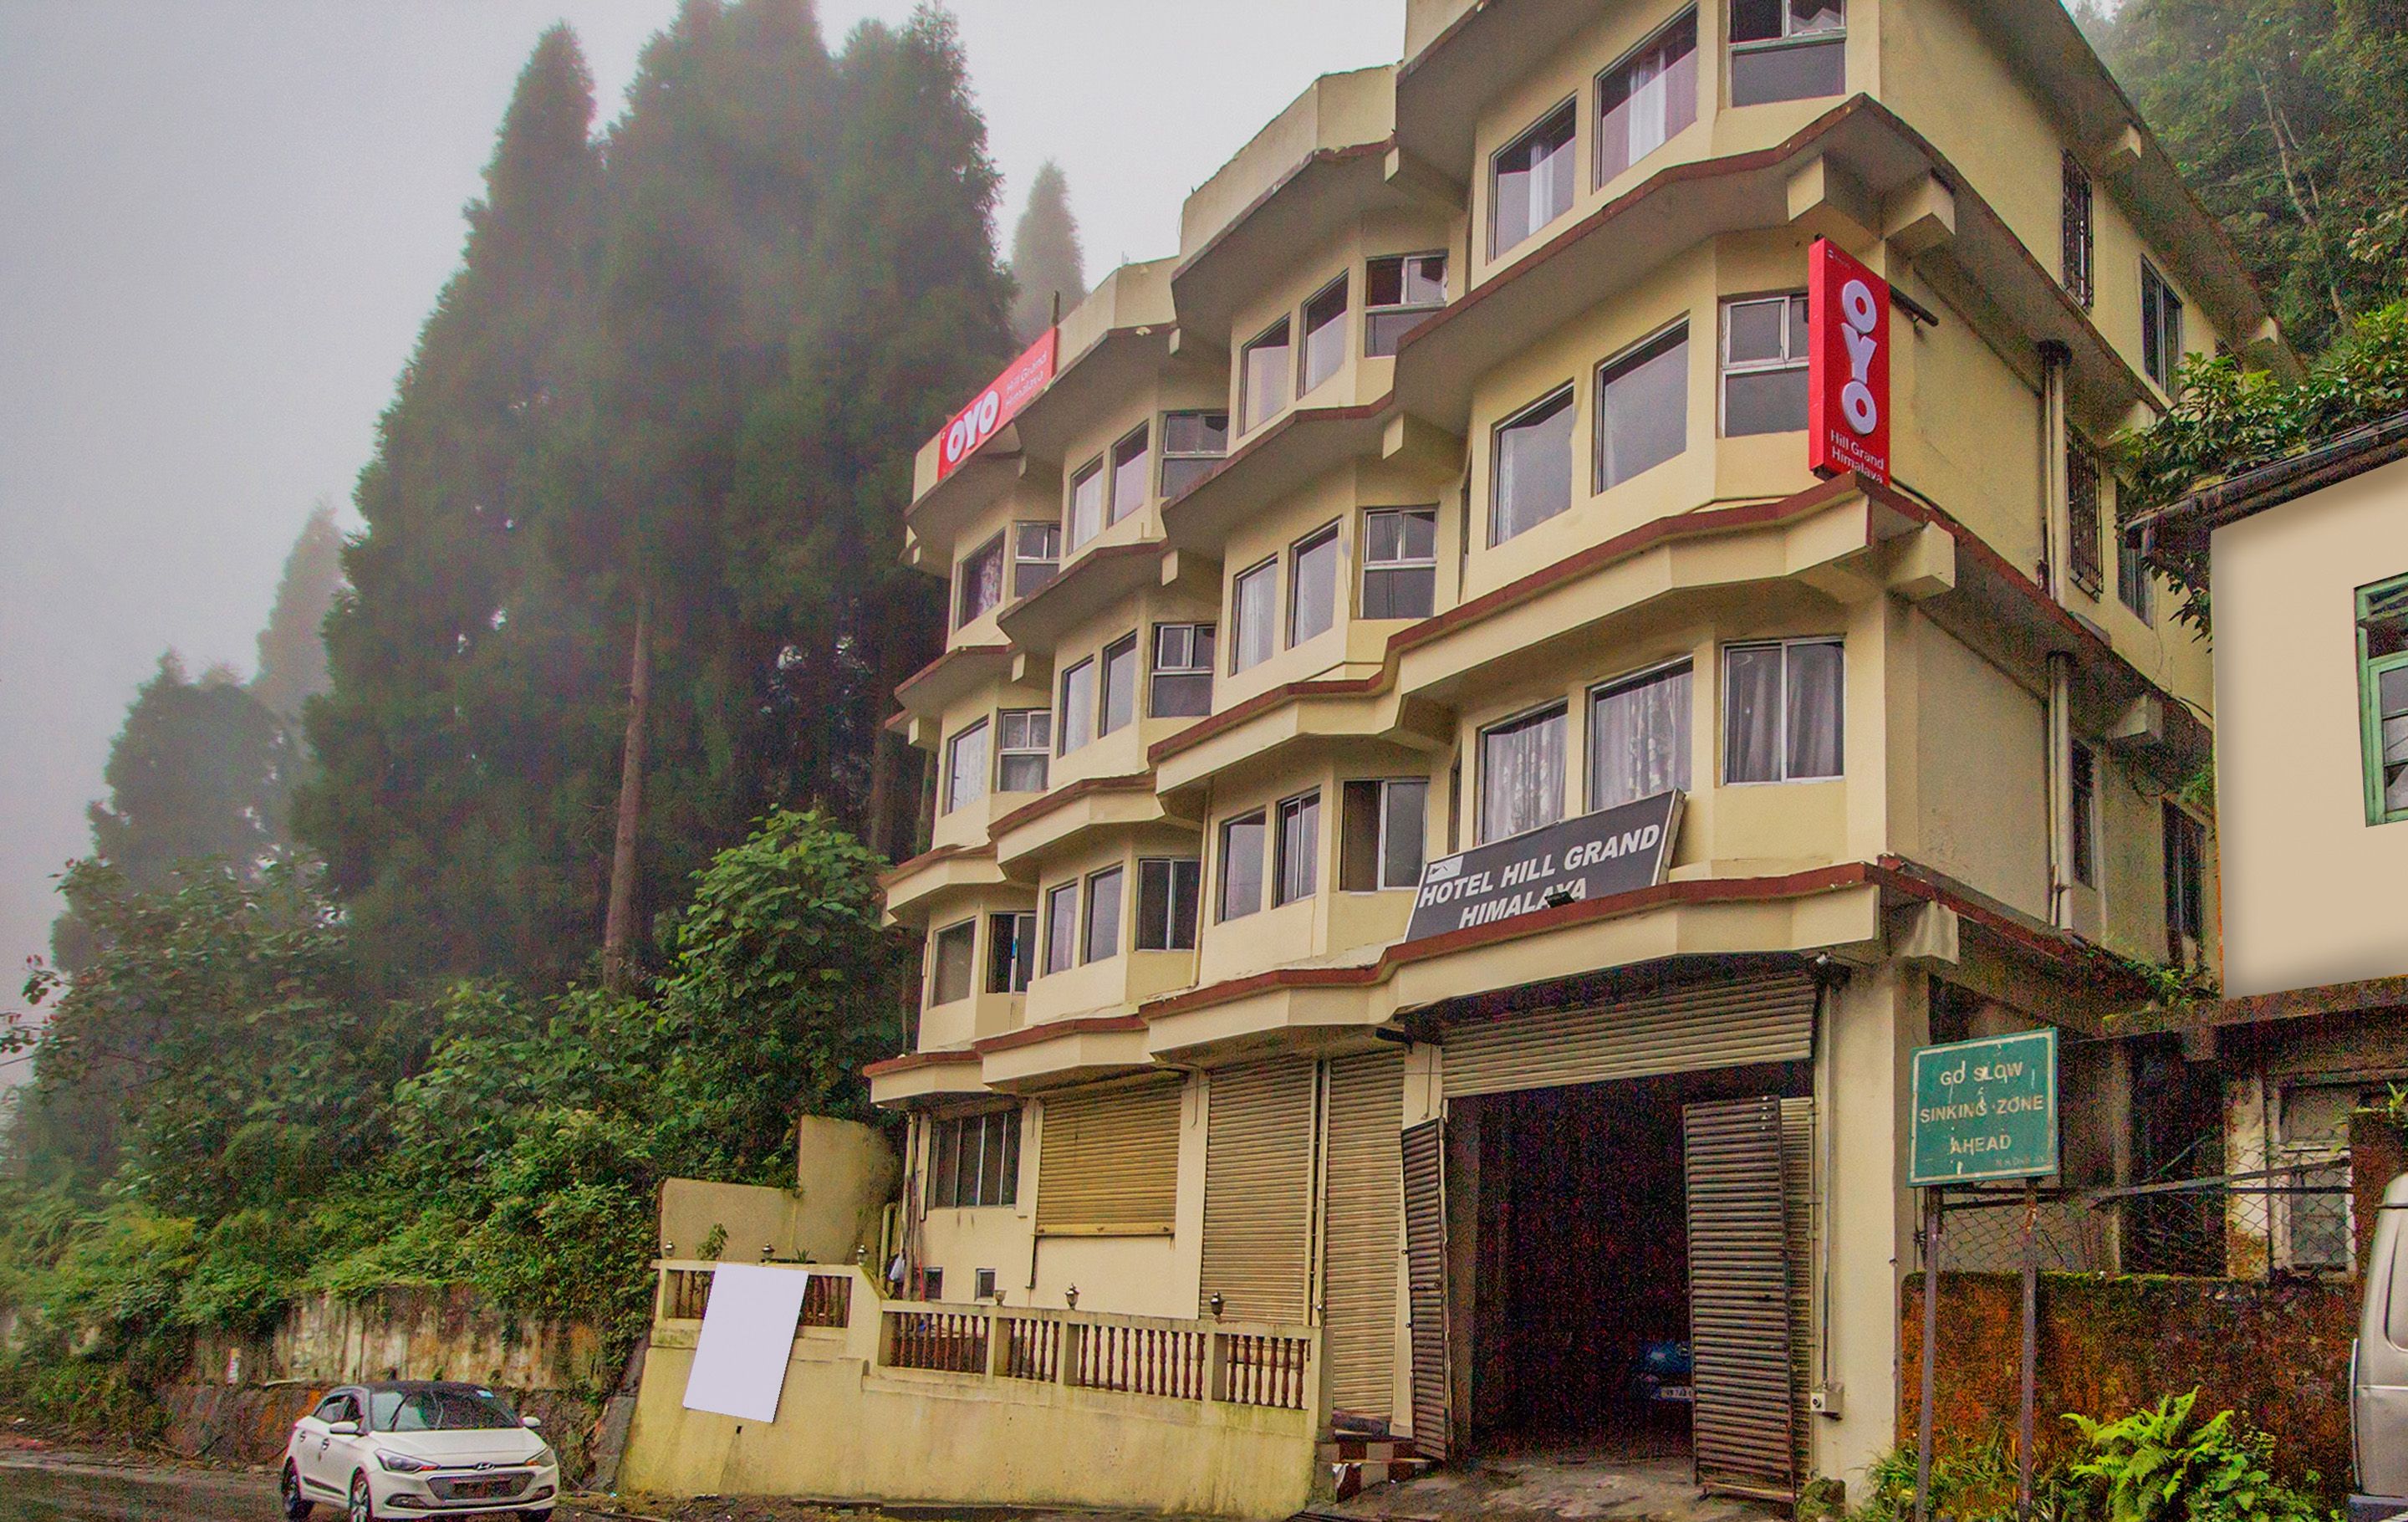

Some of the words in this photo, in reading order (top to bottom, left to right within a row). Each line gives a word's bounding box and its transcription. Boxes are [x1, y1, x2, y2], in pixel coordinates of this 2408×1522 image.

[1841, 279, 1877, 435] OYO
[946, 391, 999, 462] OYO
[1831, 429, 1849, 450] Hill
[1851, 442, 1885, 470] Grand
[1832, 446, 1883, 484] Himalaya
[1419, 871, 1492, 908] HOTEL
[1501, 854, 1556, 888] HILL
[1564, 825, 1660, 871] GRAND
[1973, 1061, 2023, 1082] SLOW
[1920, 1101, 1987, 1123] SINKING
[1996, 1095, 2043, 1115] ZONE
[1951, 1135, 2011, 1155] AHEAD
